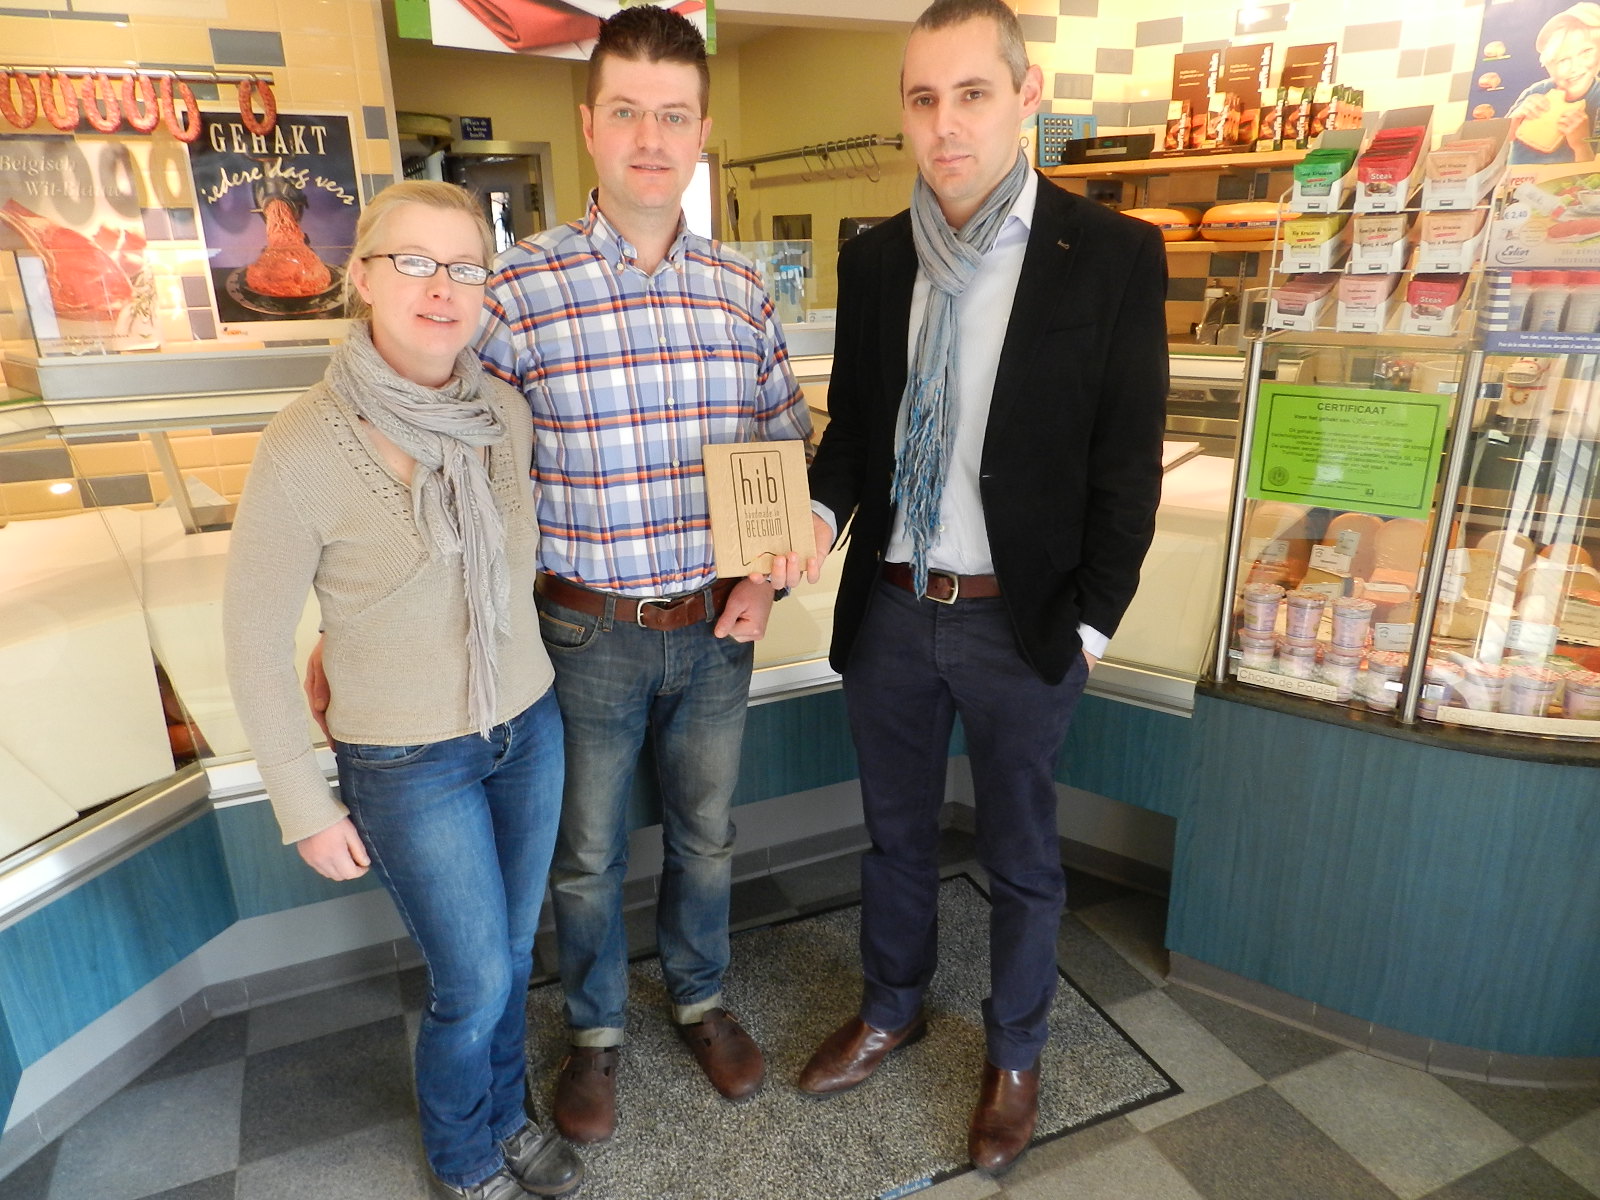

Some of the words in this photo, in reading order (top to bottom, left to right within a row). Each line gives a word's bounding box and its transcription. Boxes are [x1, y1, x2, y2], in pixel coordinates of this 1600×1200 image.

[210, 123, 327, 155] GEHAKT
[268, 156, 310, 189] dag
[1419, 296, 1442, 304] Steak
[1317, 402, 1387, 415] CERTIFICAAT
[738, 456, 778, 506] hib
[744, 506, 772, 518] handmade
[746, 517, 782, 537] BELGIUM
[1239, 669, 1275, 685] Choco
[1279, 678, 1293, 689] de
